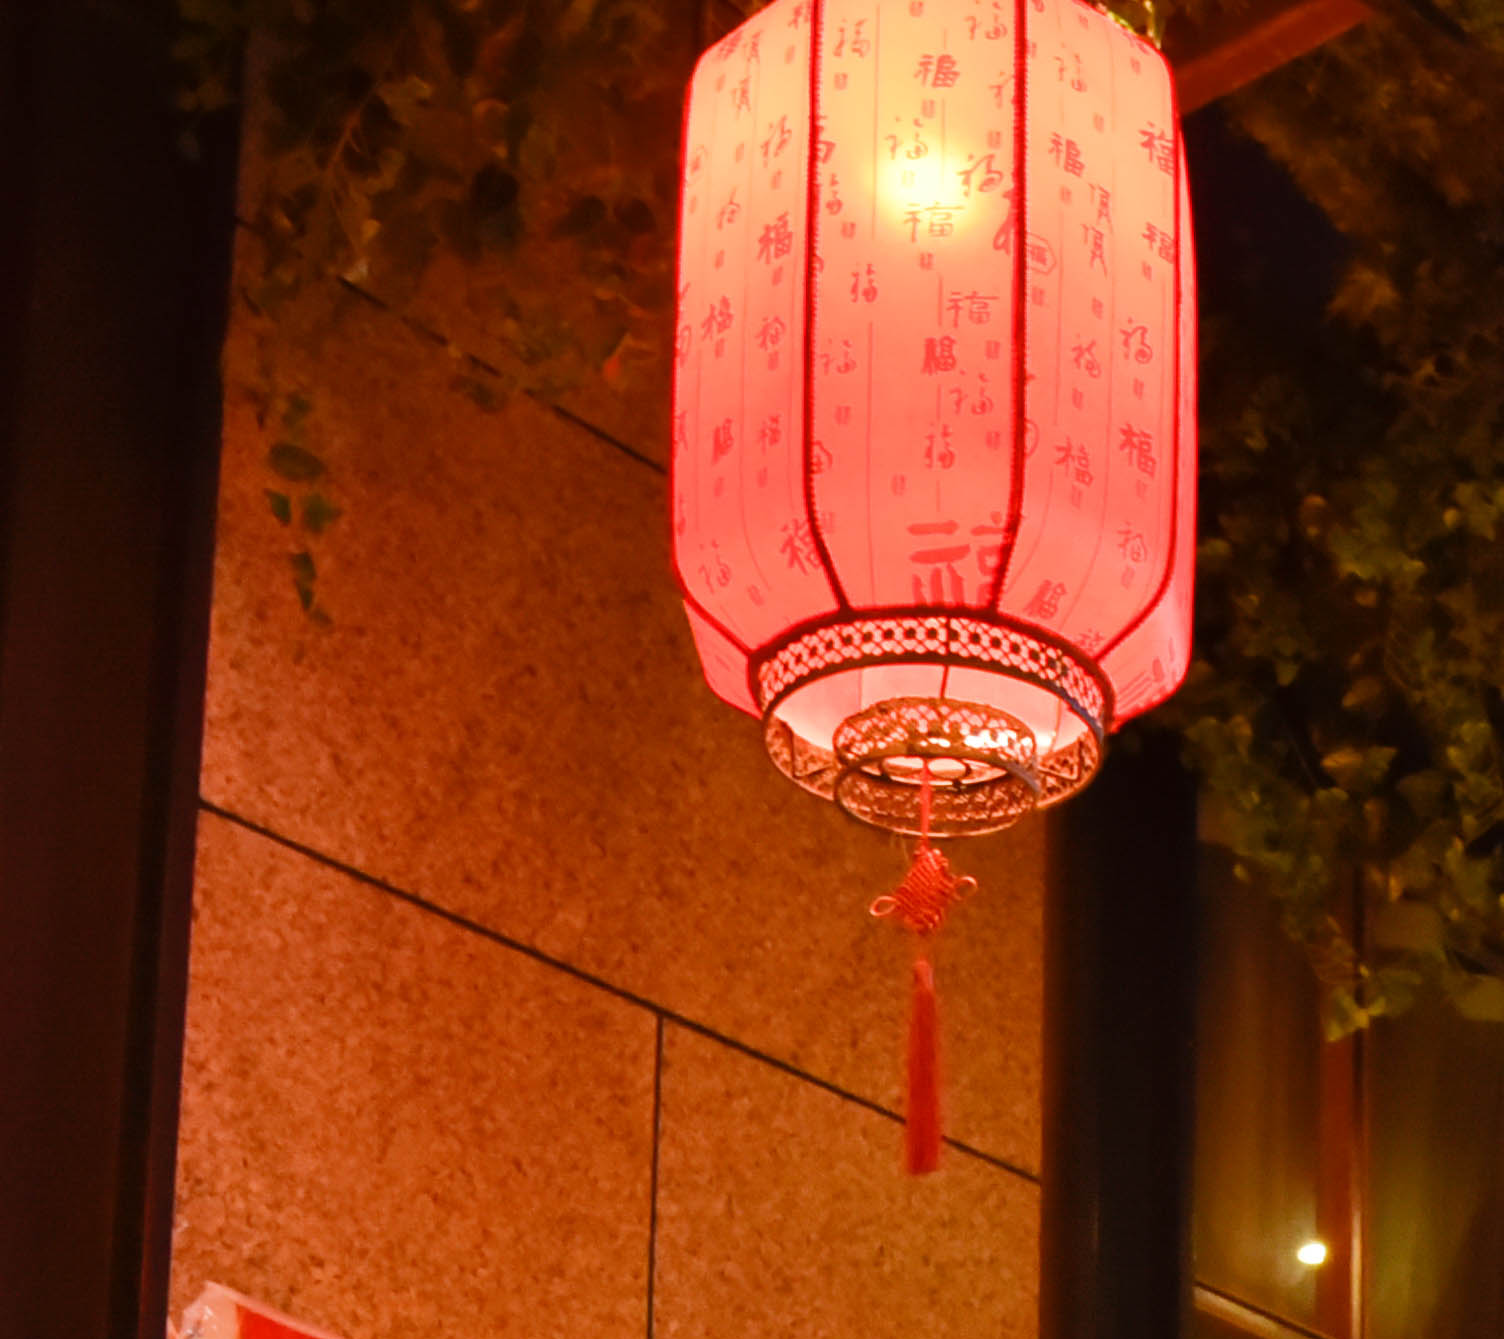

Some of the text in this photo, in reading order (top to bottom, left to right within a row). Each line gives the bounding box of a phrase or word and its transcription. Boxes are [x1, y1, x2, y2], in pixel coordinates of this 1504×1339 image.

[913, 53, 960, 89] 福
[1048, 131, 1086, 178] 福
[903, 201, 966, 243] 福
[946, 290, 1000, 330] 福
